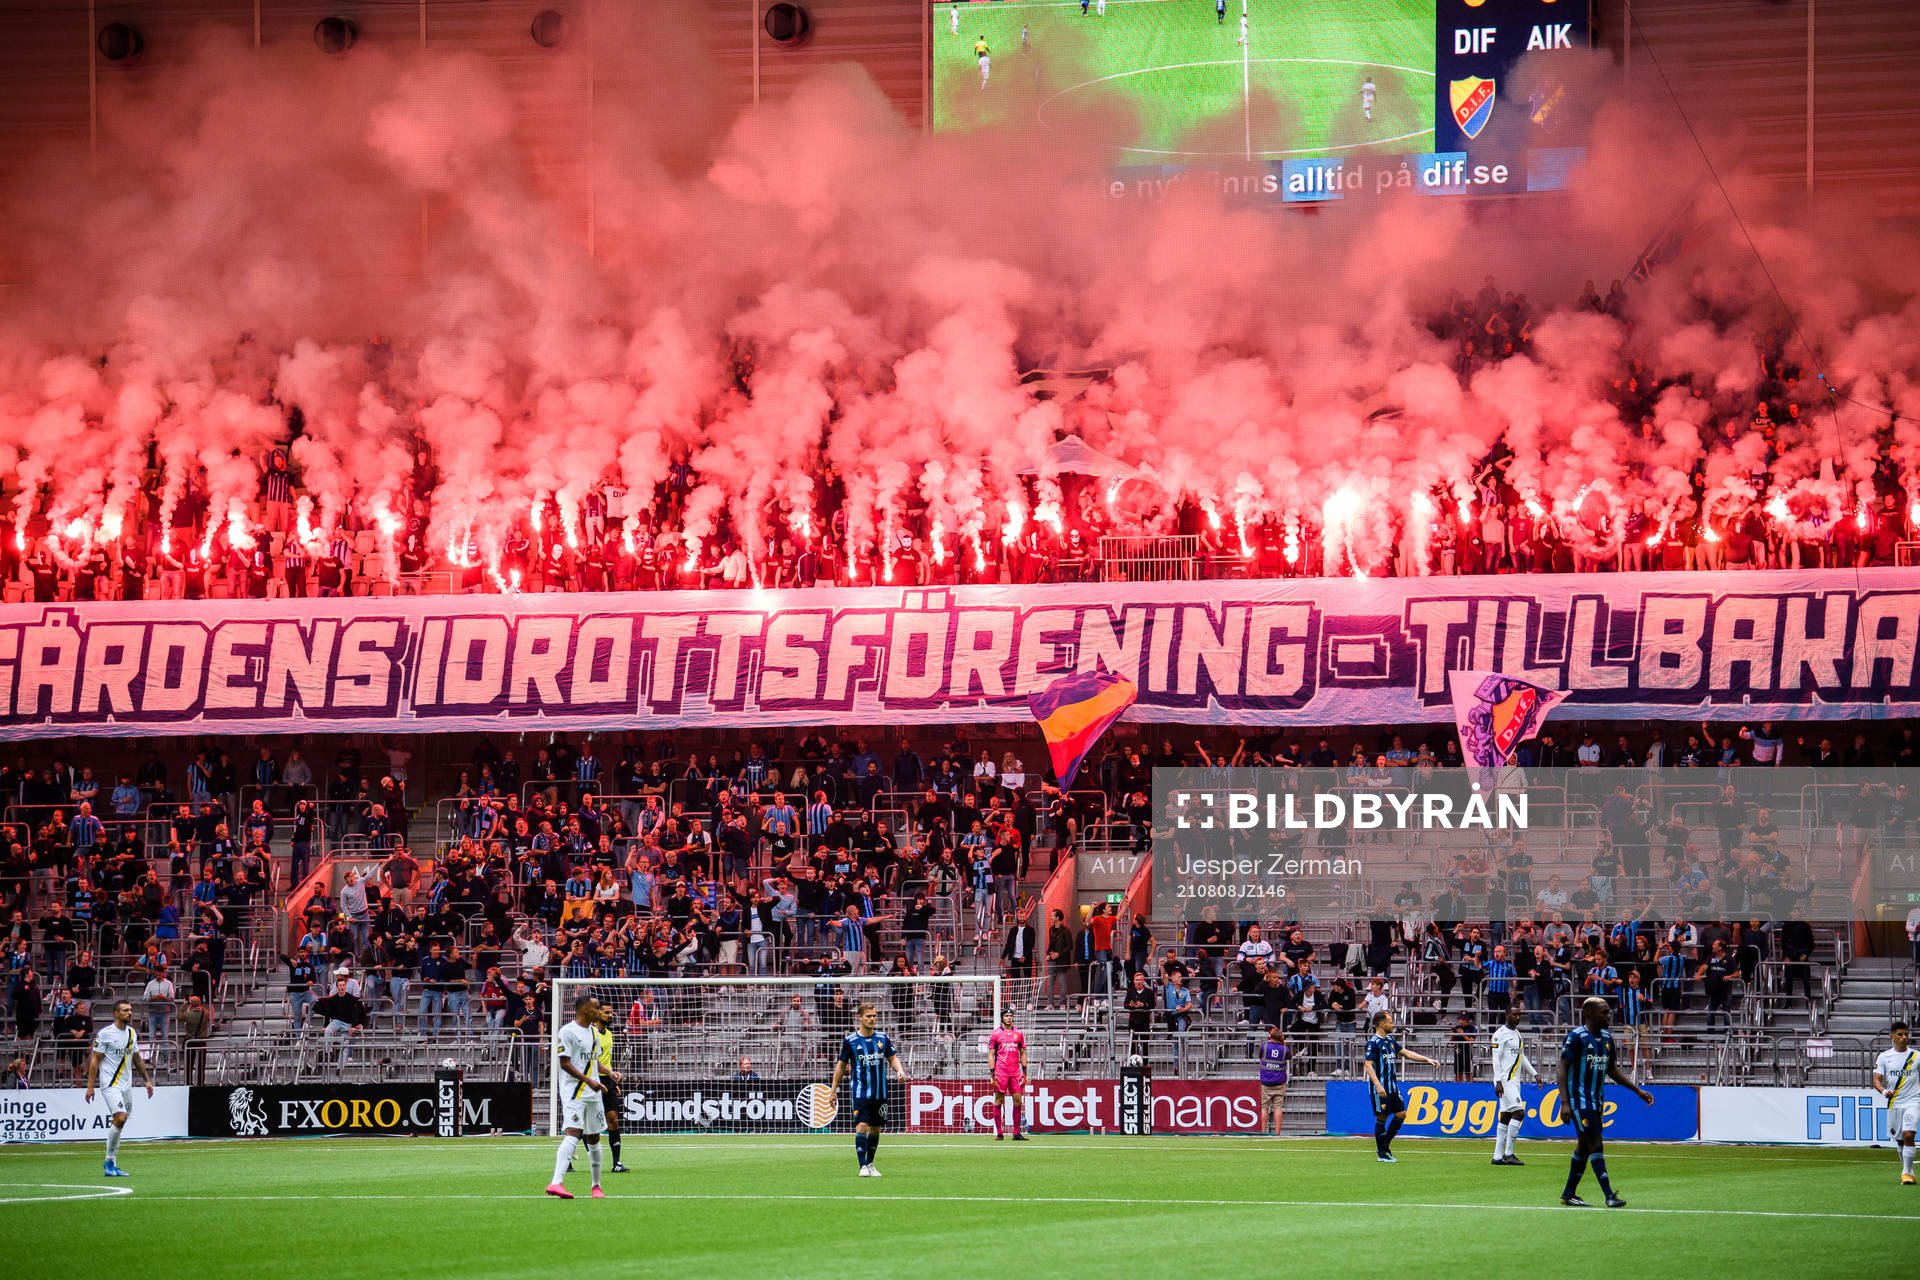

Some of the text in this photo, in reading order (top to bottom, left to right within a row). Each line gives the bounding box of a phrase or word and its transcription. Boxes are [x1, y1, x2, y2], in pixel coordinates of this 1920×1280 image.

[1455, 28, 1497, 54] DIF
[1526, 24, 1572, 50] AIK
[1288, 165, 1363, 192] alltid
[1376, 162, 1412, 194] på
[1423, 160, 1509, 187] dif.se
[0, 610, 400, 716] ÅRDENS
[1091, 857, 1138, 874] A117
[1271, 1049, 1279, 1057] 19
[0, 1098, 47, 1118] inge
[278, 1098, 492, 1129] FXORO.CM
[439, 1079, 454, 1137] SELECT
[626, 1092, 793, 1121] Sundström
[1114, 1085, 1257, 1128] nans
[1123, 1075, 1138, 1135] SELECT
[1143, 1075, 1151, 1135] SELECT
[18, 1131, 30, 1139] 16
[33, 1131, 46, 1139] 36
